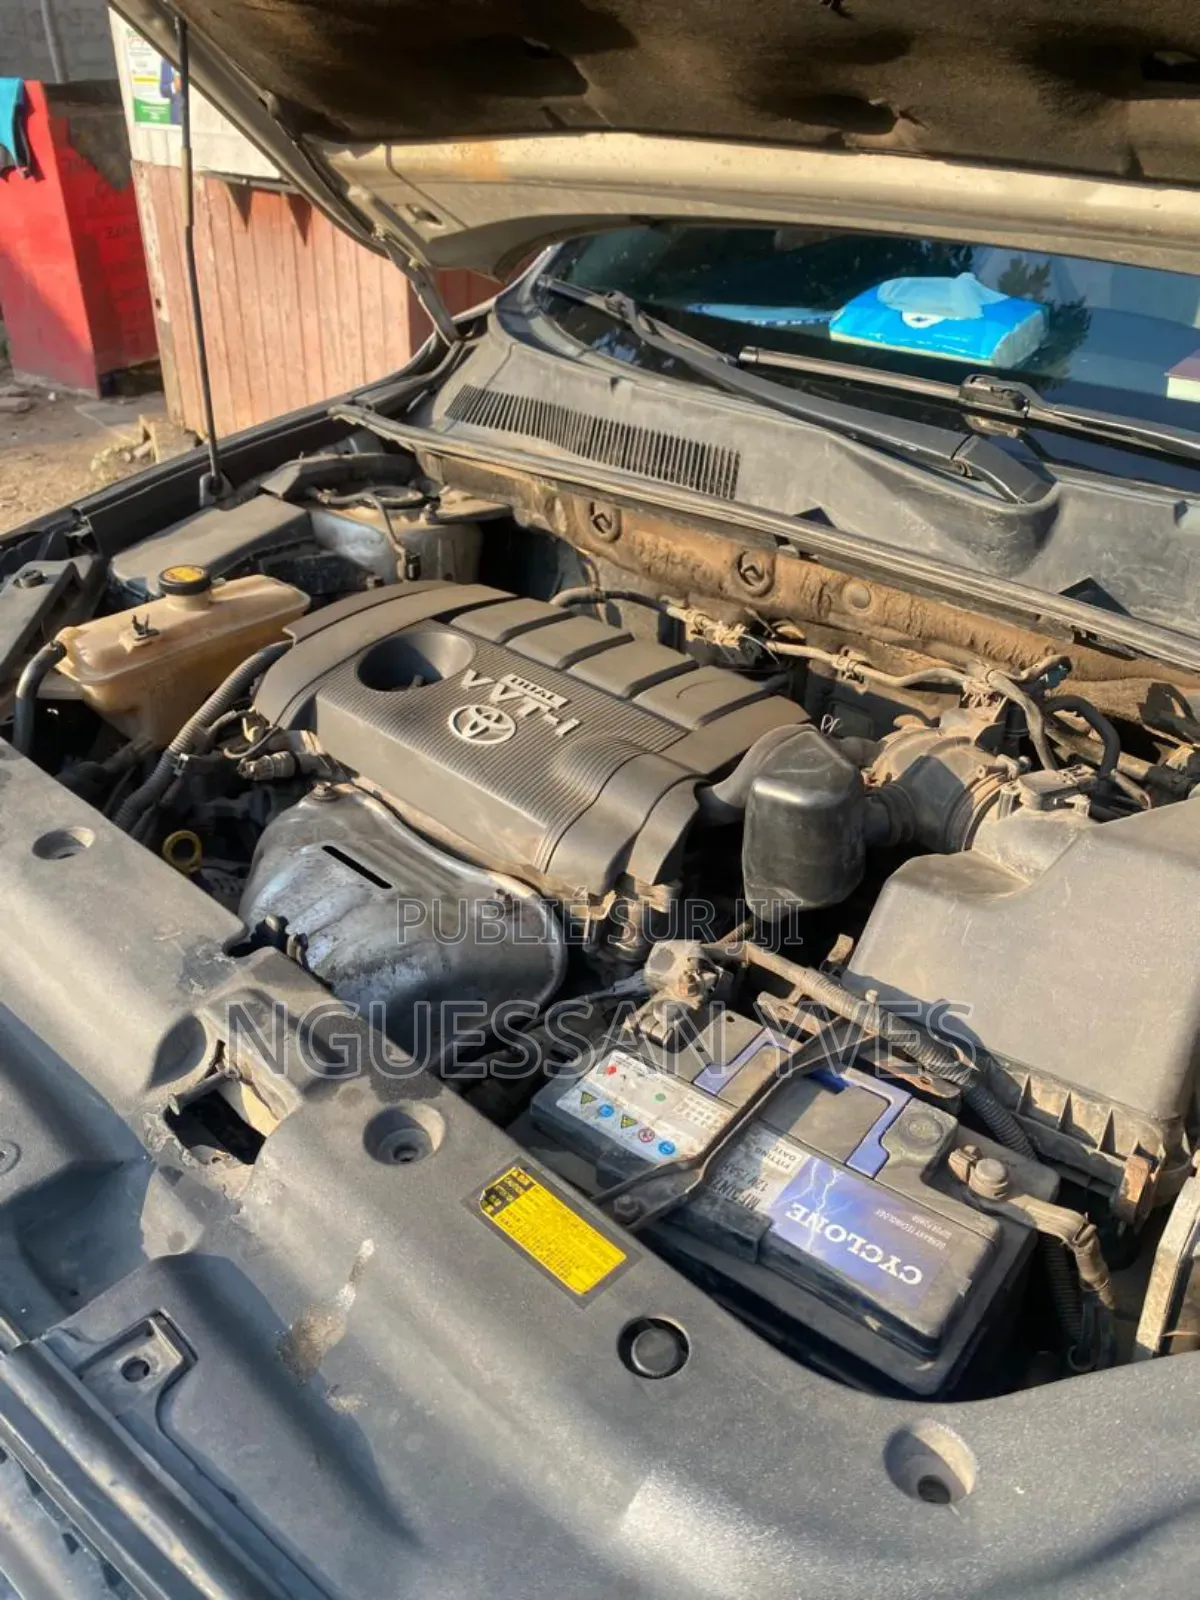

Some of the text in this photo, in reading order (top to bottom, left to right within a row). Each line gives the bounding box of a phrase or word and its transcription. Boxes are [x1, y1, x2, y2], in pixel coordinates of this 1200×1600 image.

[509, 676, 557, 704] DUAL
[755, 1146, 790, 1169] FITTING
[785, 1202, 923, 1286] CYCLONE
